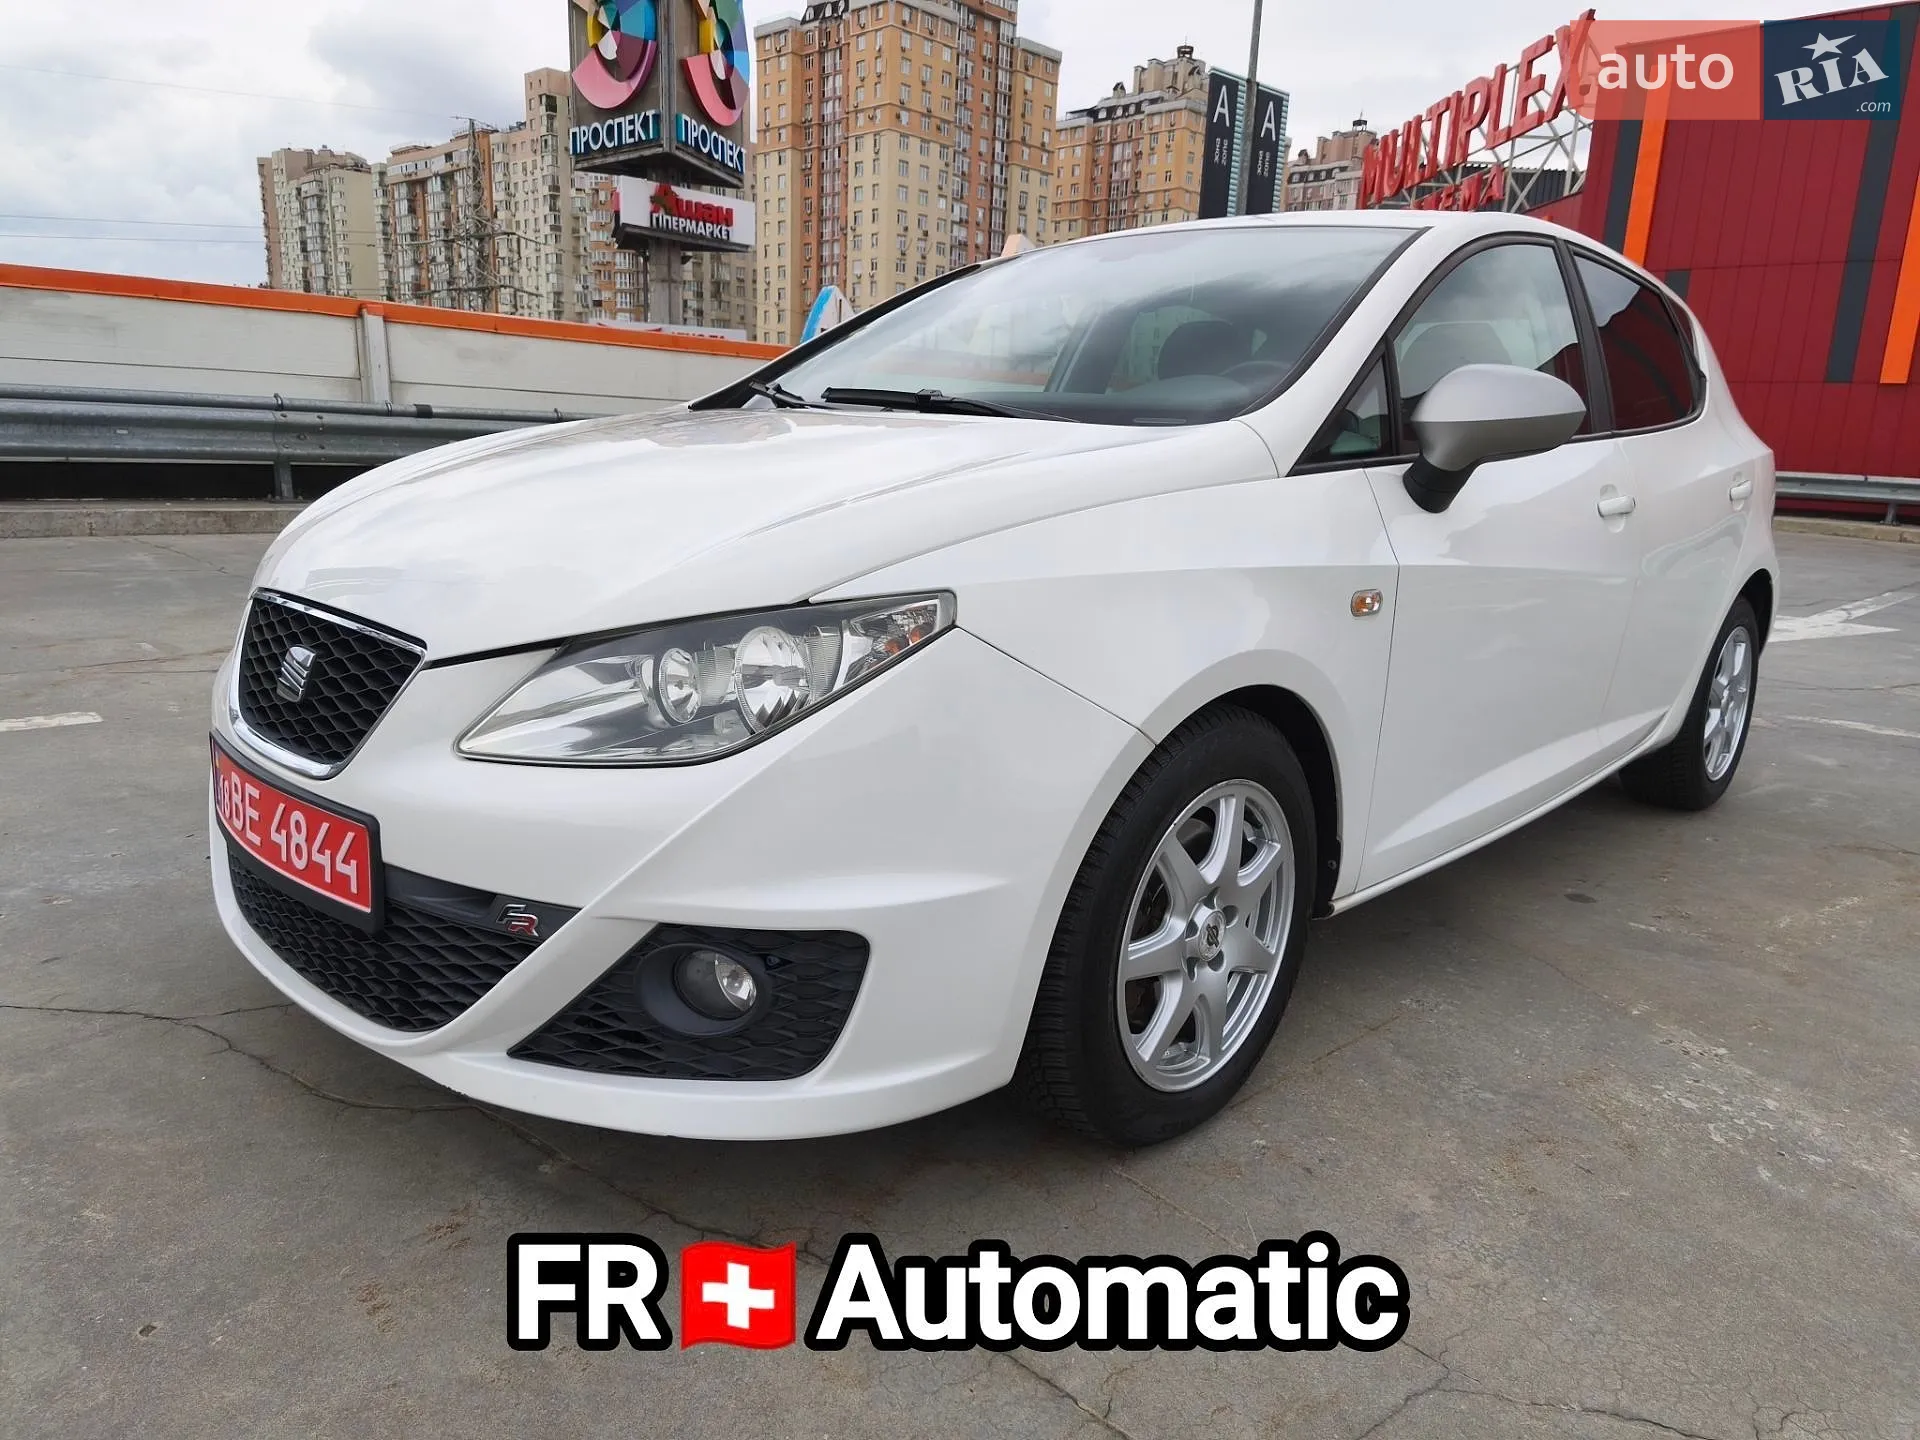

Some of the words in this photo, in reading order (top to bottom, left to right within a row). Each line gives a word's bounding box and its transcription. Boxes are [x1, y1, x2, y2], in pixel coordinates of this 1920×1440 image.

[569, 109, 656, 155] ПРОСПЕКТ
[1356, 8, 1597, 209] MULTIPLEX
[682, 113, 746, 175] ПРОСПЕКТ
[270, 803, 357, 894] 4844
[495, 903, 539, 937] FR
